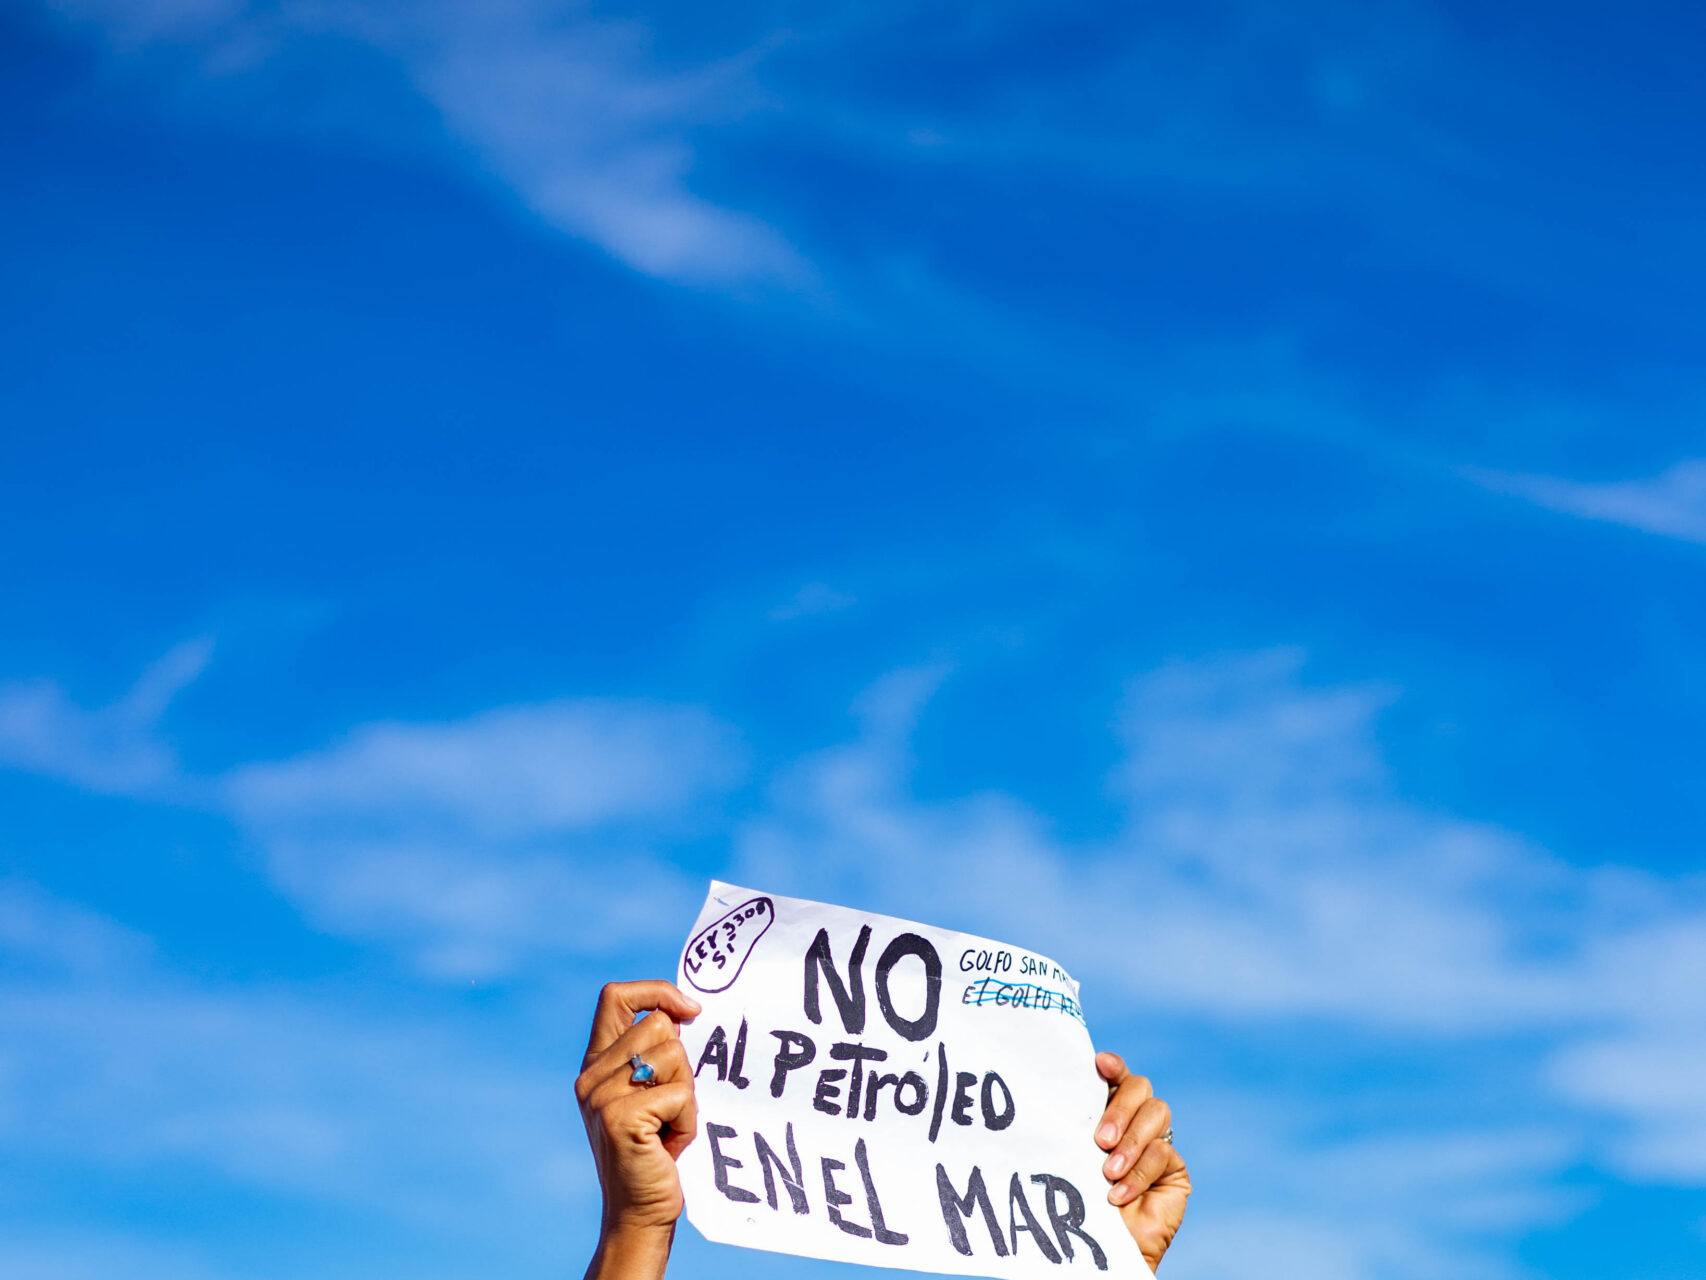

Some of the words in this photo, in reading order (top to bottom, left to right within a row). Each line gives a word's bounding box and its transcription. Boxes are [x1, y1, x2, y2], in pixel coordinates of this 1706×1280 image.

[685, 929, 718, 974] LEY
[959, 948, 1013, 974] GOLFO
[1019, 955, 1048, 976] SAN
[804, 924, 943, 1042] NO
[995, 984, 1052, 1011] GOLFO
[935, 1162, 1109, 1271] MAR
